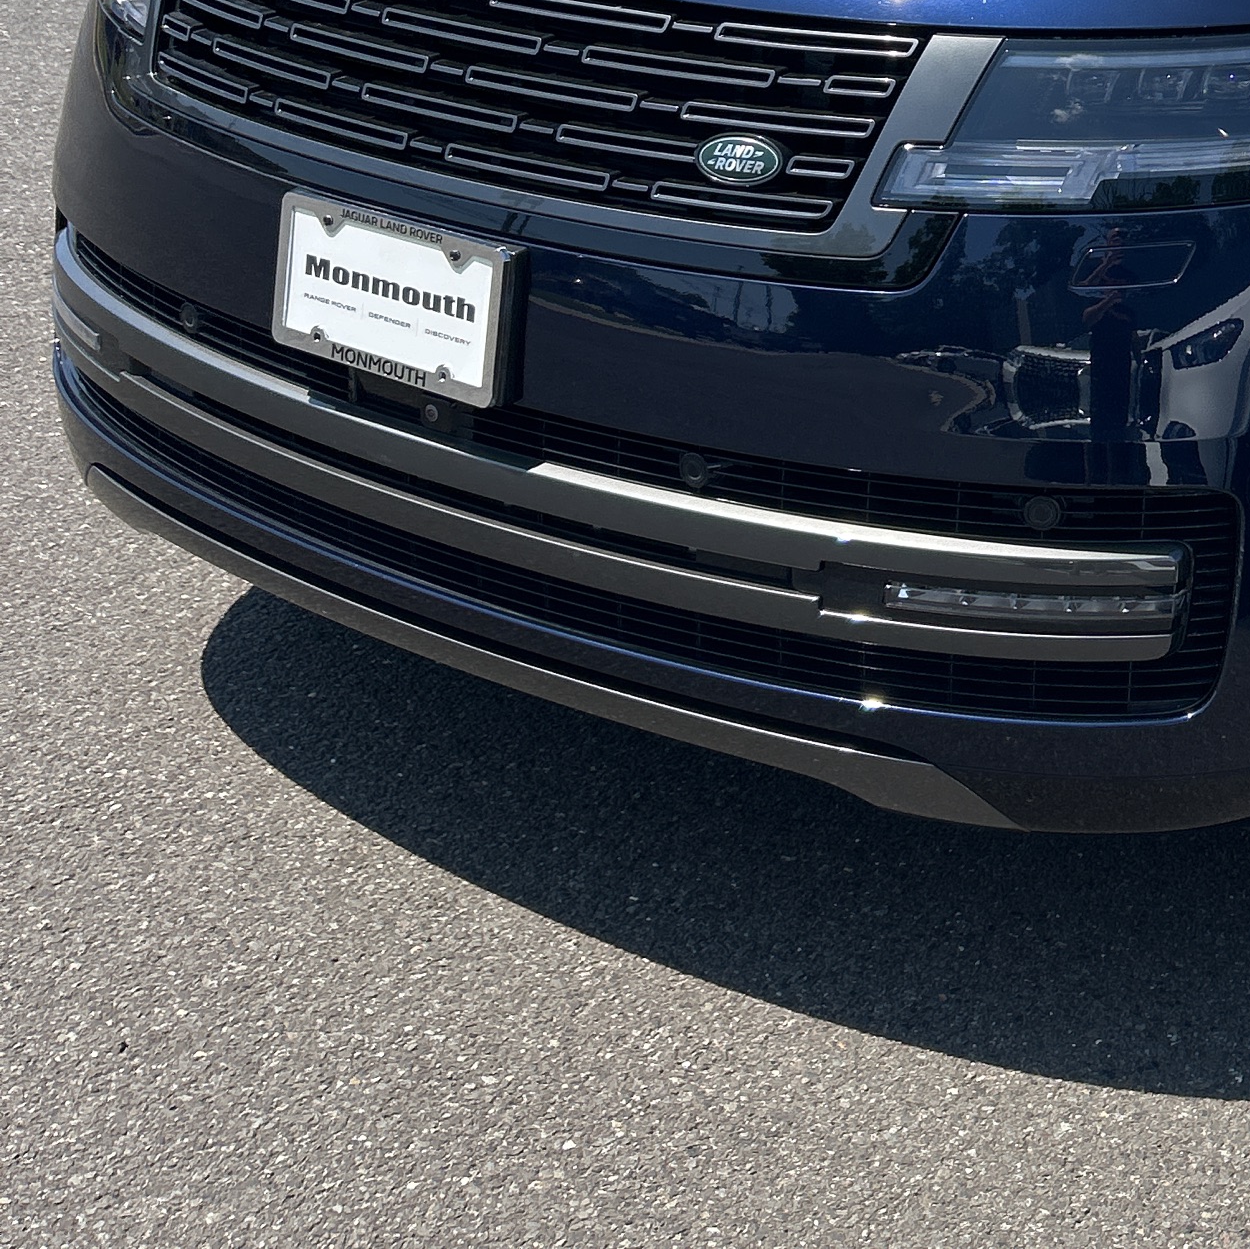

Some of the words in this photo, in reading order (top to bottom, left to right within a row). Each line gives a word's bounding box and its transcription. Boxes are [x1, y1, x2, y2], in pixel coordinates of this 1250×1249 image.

[713, 142, 755, 159] LAND
[714, 157, 765, 175] ROVER
[340, 208, 378, 227] JAGUAR
[379, 217, 408, 235] LAND
[409, 225, 443, 245] ROVER
[304, 253, 476, 324] Monmouth
[303, 292, 331, 306] RANGE
[331, 300, 357, 313] ROVER
[368, 311, 412, 329] DEFENDER
[424, 328, 472, 347] DISCOVERY
[330, 343, 427, 388] MONMOUTH
